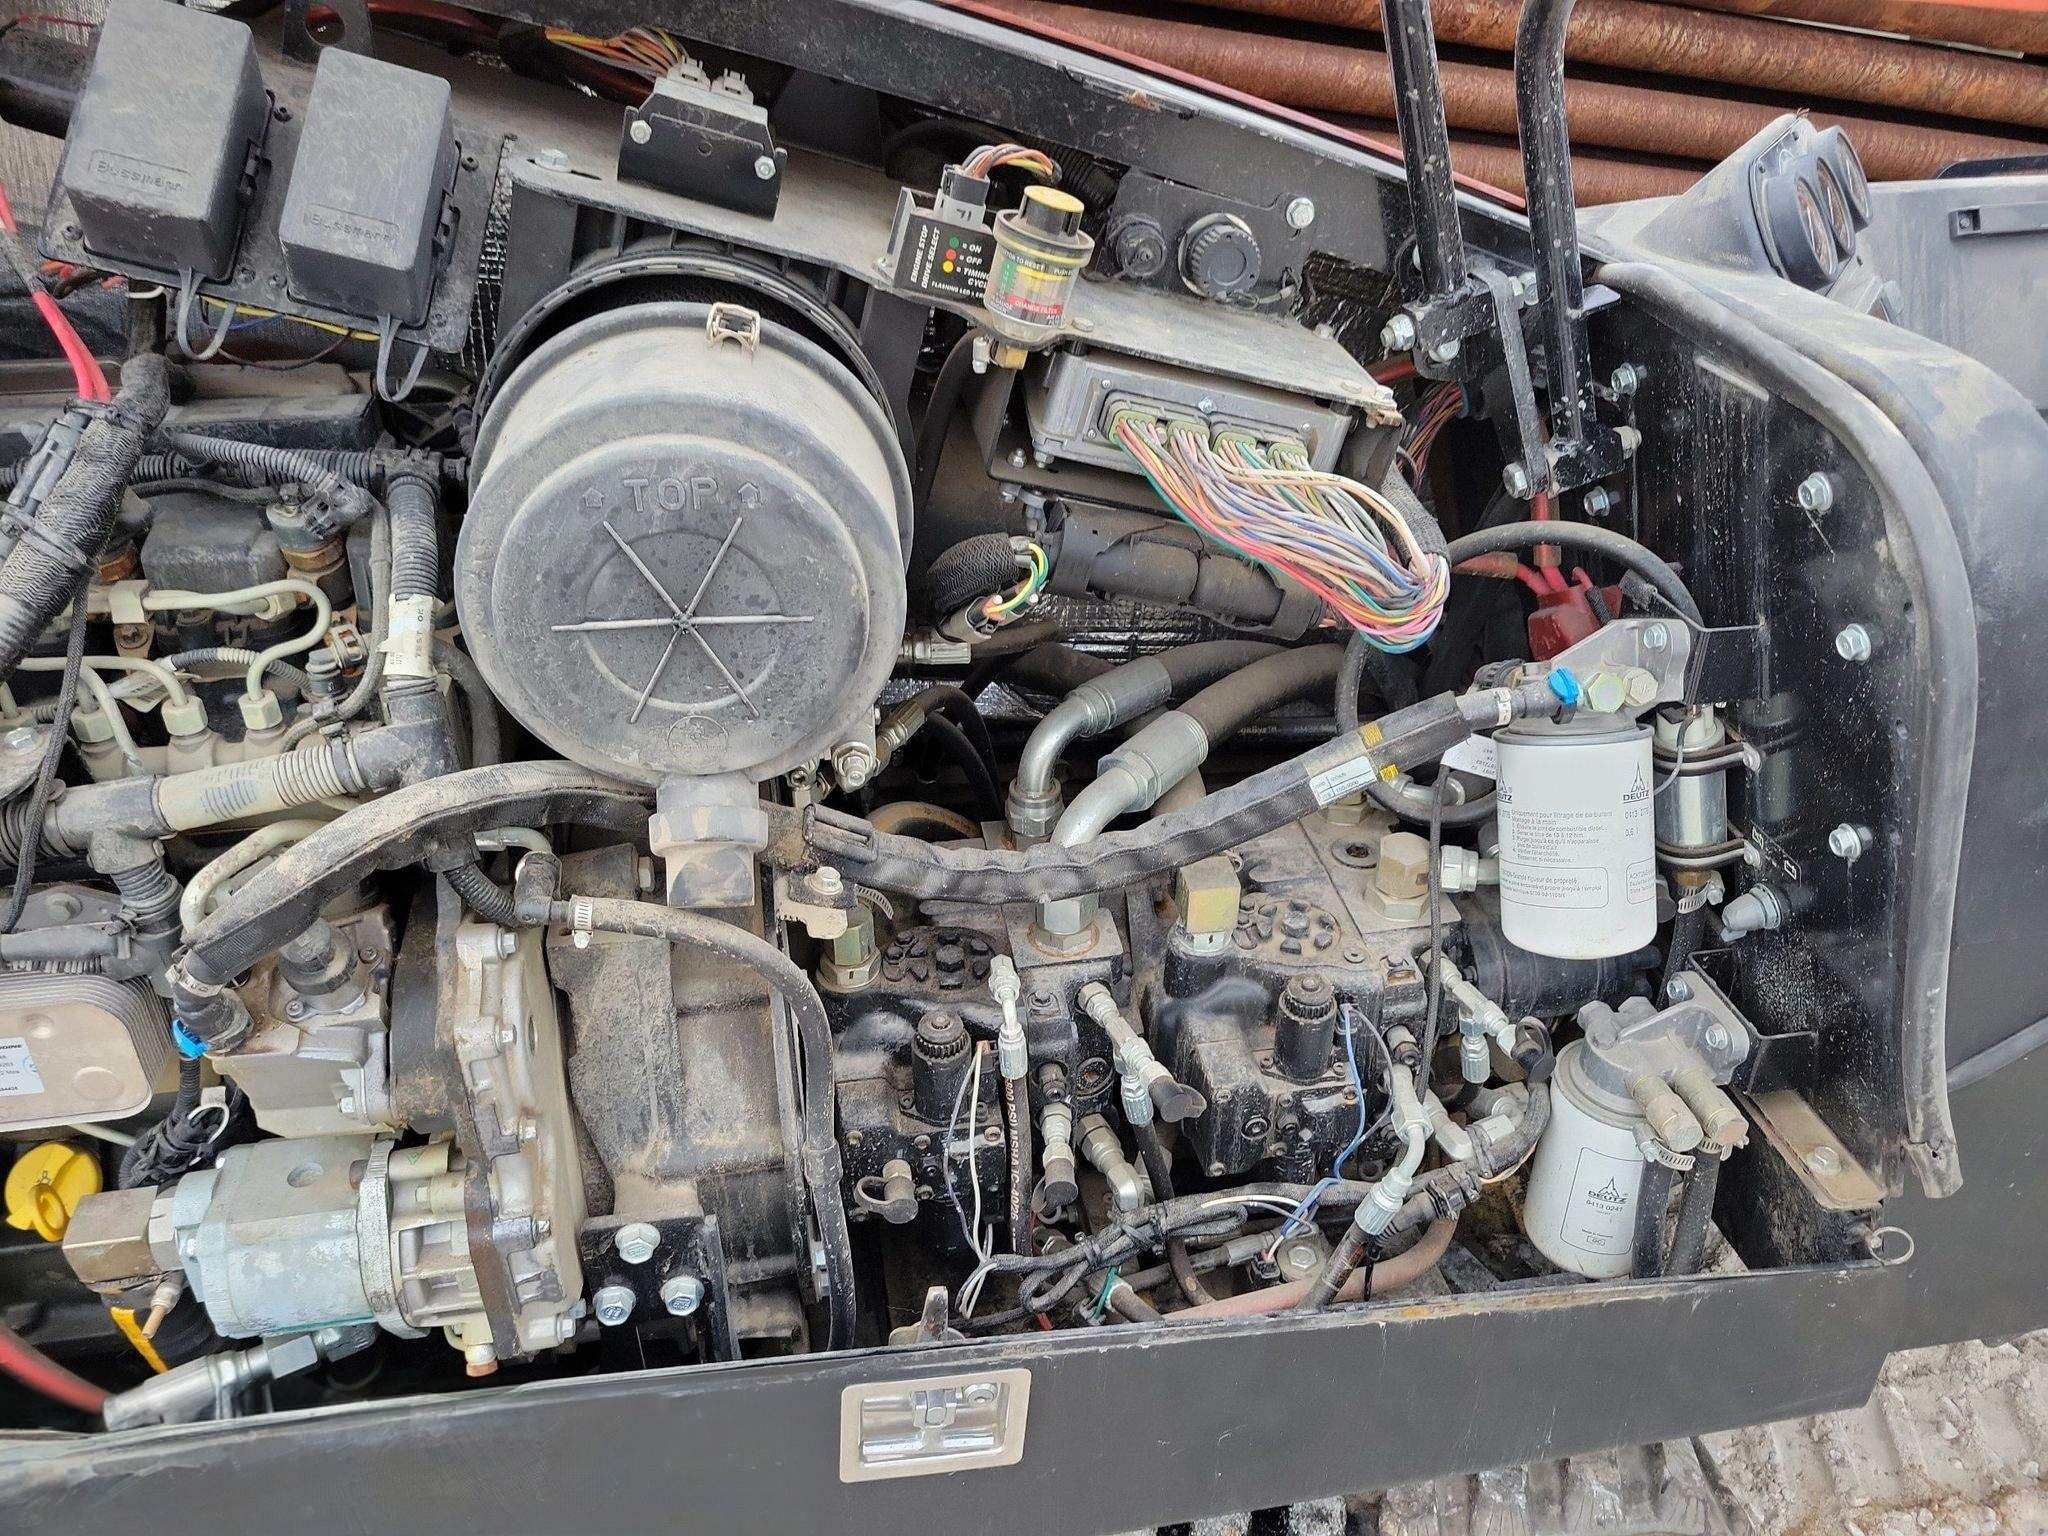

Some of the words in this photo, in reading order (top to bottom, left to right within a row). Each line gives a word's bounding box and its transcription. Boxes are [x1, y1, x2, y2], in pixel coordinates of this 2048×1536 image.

[910, 248, 924, 283] ENGINE
[918, 224, 929, 248] STOP
[968, 244, 982, 254] ON
[921, 261, 933, 289] DRIVE
[928, 226, 940, 261] SELECT
[966, 255, 983, 266] OFF
[1024, 260, 1045, 271] RESET
[967, 278, 988, 289] CYCL
[623, 475, 719, 512] TOP
[1623, 789, 1649, 801] DEUTZ
[1008, 1103, 1019, 1128] PSI)
[1010, 1128, 1019, 1168] MSHA
[1588, 1190, 1627, 1202] DEUTZ
[1586, 1199, 1604, 1209] 0413
[1605, 1204, 1623, 1213] 0241
